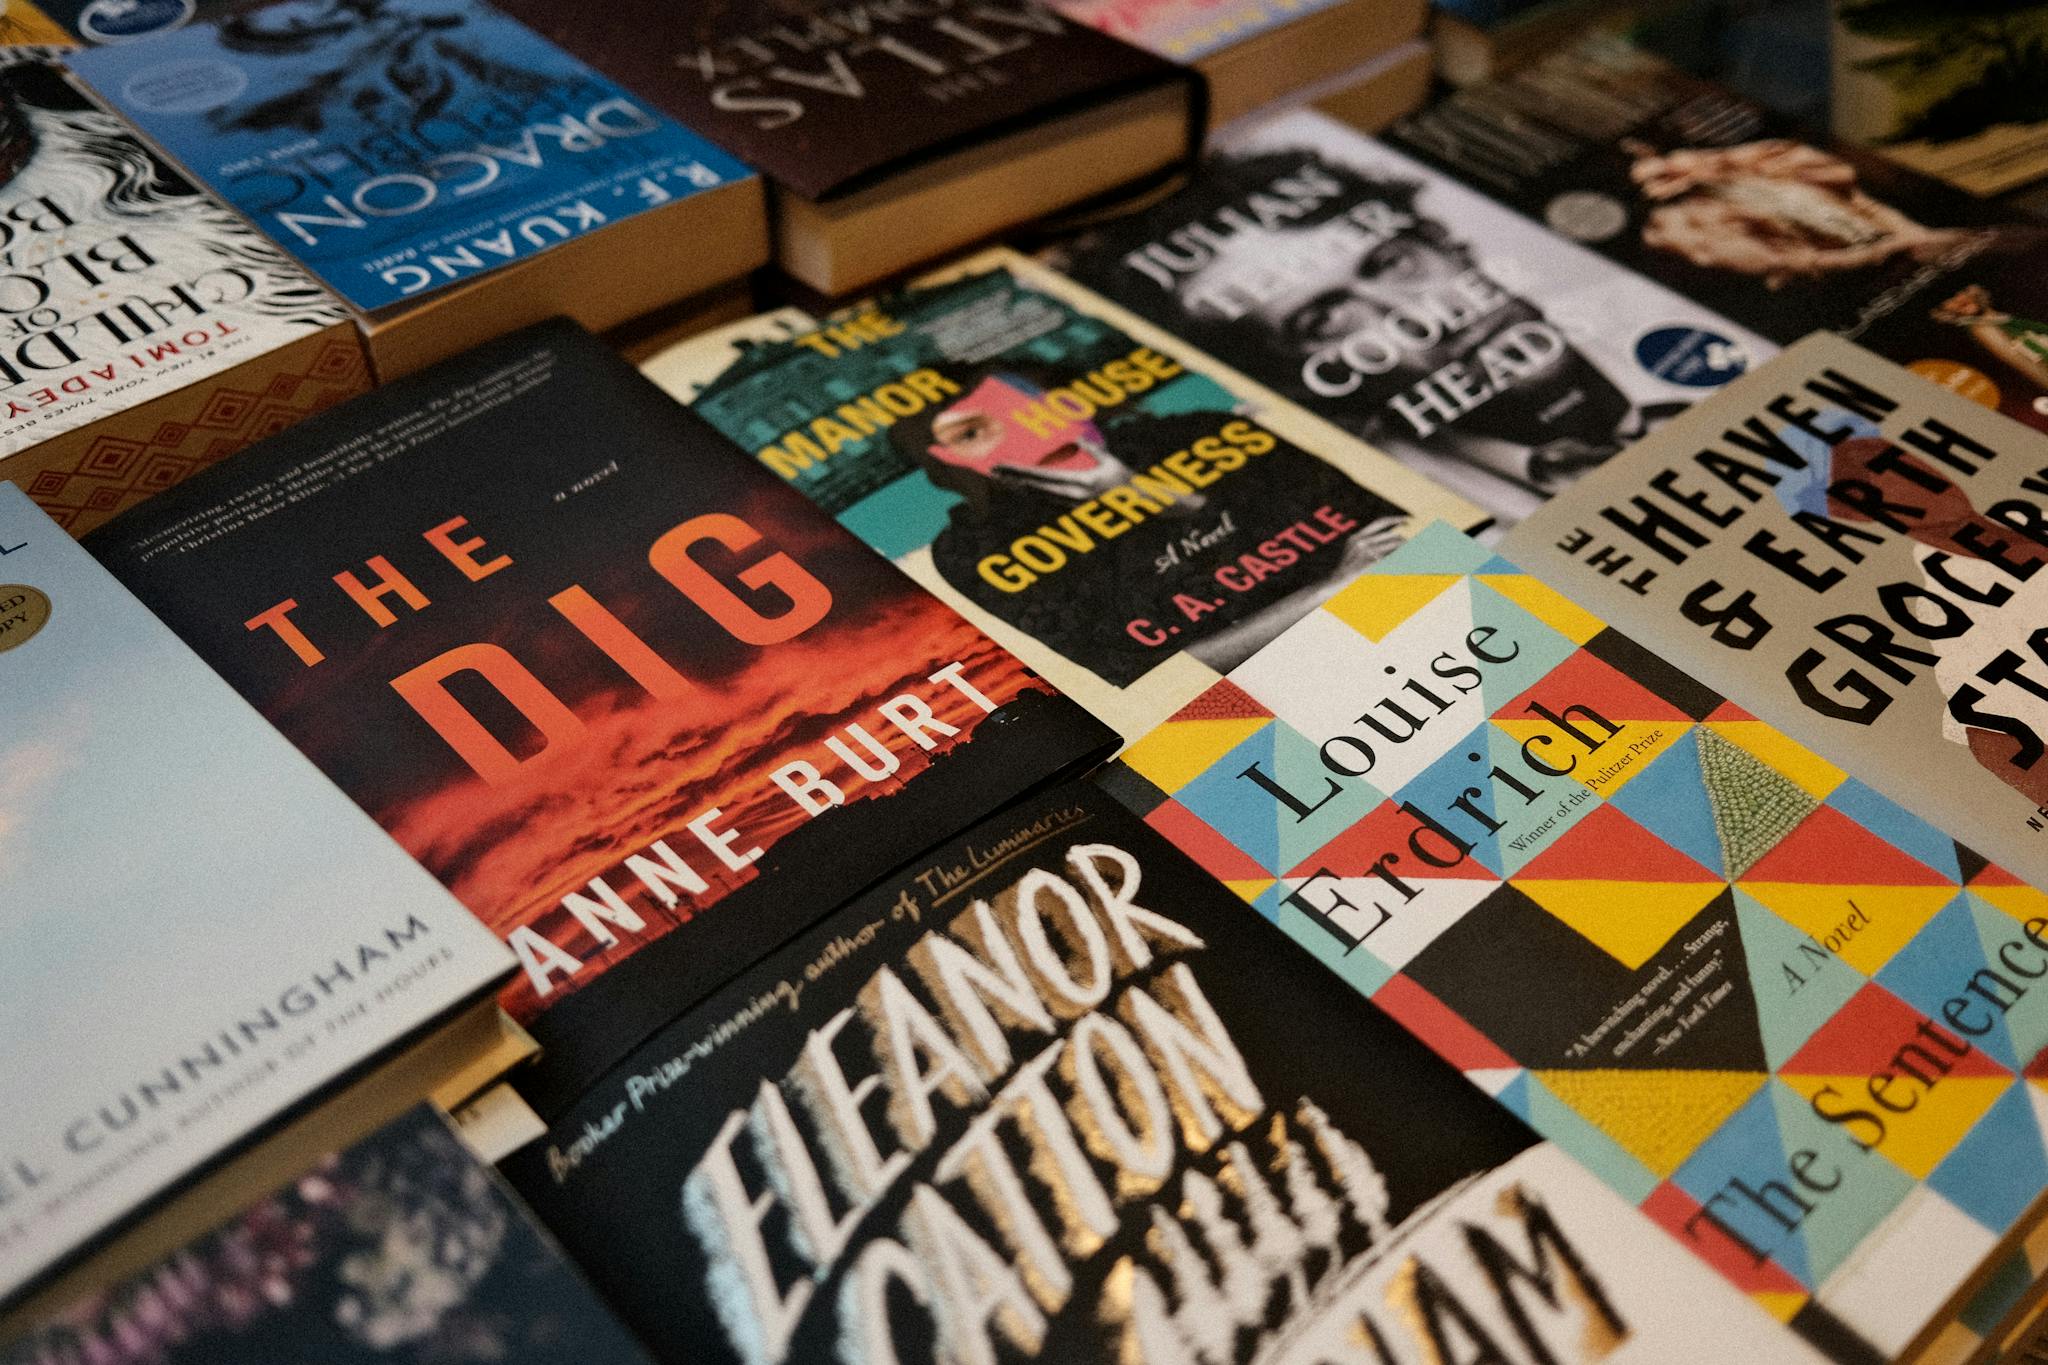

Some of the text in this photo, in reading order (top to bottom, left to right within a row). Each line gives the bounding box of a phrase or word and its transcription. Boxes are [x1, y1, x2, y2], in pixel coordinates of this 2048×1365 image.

[280, 98, 666, 246] DRAGON
[1124, 162, 1343, 292] JULIAN
[380, 200, 605, 296] KUANG
[7, 320, 240, 419] TOMI ADEY
[104, 376, 150, 397] YORK
[157, 358, 193, 377] NEW
[796, 309, 904, 358] THE
[1013, 347, 1187, 440] HOUSE
[43, 396, 97, 420] TIMES
[757, 367, 962, 481] MANOR
[1599, 368, 1899, 567] HEAVEN
[569, 460, 620, 499] novel
[977, 421, 1277, 595] GOVERNESS
[1680, 418, 1998, 650] & EARTH
[244, 514, 514, 668] THE
[1125, 505, 1359, 648] C. A. CASTLE
[1153, 511, 1238, 574] A Novel
[1557, 526, 1664, 596] THE
[388, 512, 833, 790] DIG
[1236, 622, 1521, 826] Louise
[508, 661, 999, 997] ANNE BURT
[1280, 700, 1626, 958] Erdrich
[1508, 729, 1663, 852] Winner of the Pulitzer Prize
[376, 948, 453, 1001] HOURS
[548, 803, 1088, 1187] Booker Prize-winning author of The Luminaries
[1583, 996, 1646, 1045] bewitching
[1684, 920, 1729, 954] Strange,
[1678, 1004, 1703, 1028] York
[1701, 982, 1732, 1010] Times
[1780, 899, 1872, 994] A Novel
[63, 912, 430, 1154] CUNNINGHAM
[1613, 1004, 1674, 1055] enchanting,
[1673, 981, 1691, 1002] and
[684, 843, 1204, 1365] ELEANOR
[1684, 917, 2048, 1268] The Sentence
[838, 962, 1264, 1365] CATTON
